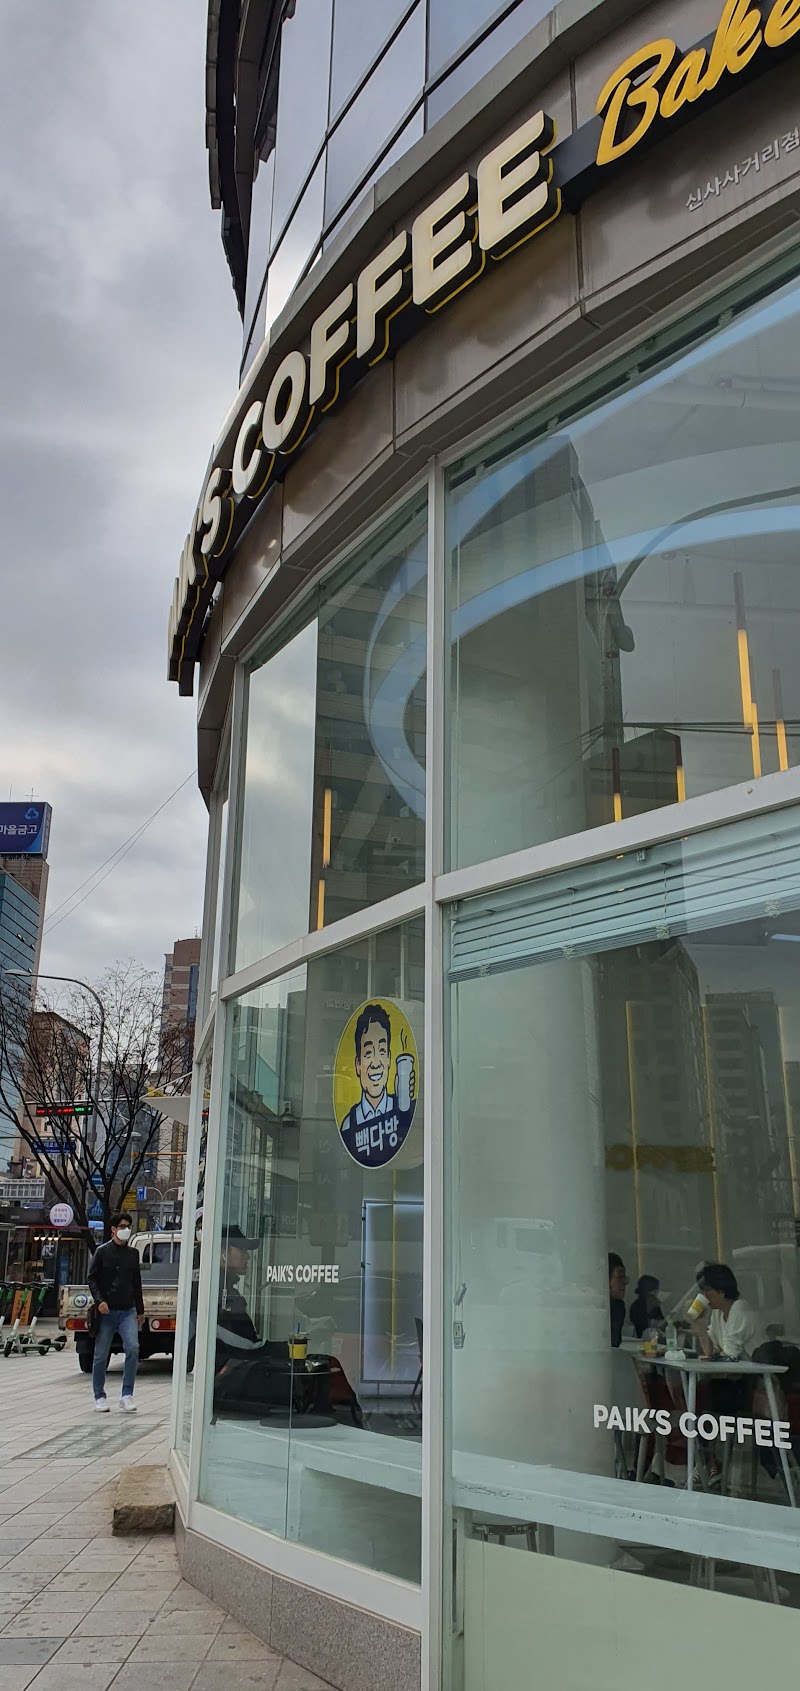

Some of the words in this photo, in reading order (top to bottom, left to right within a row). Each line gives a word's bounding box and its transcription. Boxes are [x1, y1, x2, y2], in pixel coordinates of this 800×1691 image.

[685, 126, 800, 212] 신사사거리점
[232, 110, 551, 496] COFFEE
[355, 1114, 400, 1157] 빽다방
[266, 1265, 294, 1283] PAIK'S
[295, 1264, 340, 1284] COFFEE
[593, 1404, 672, 1436] PAIK'S
[679, 1411, 792, 1450] COFFEE
